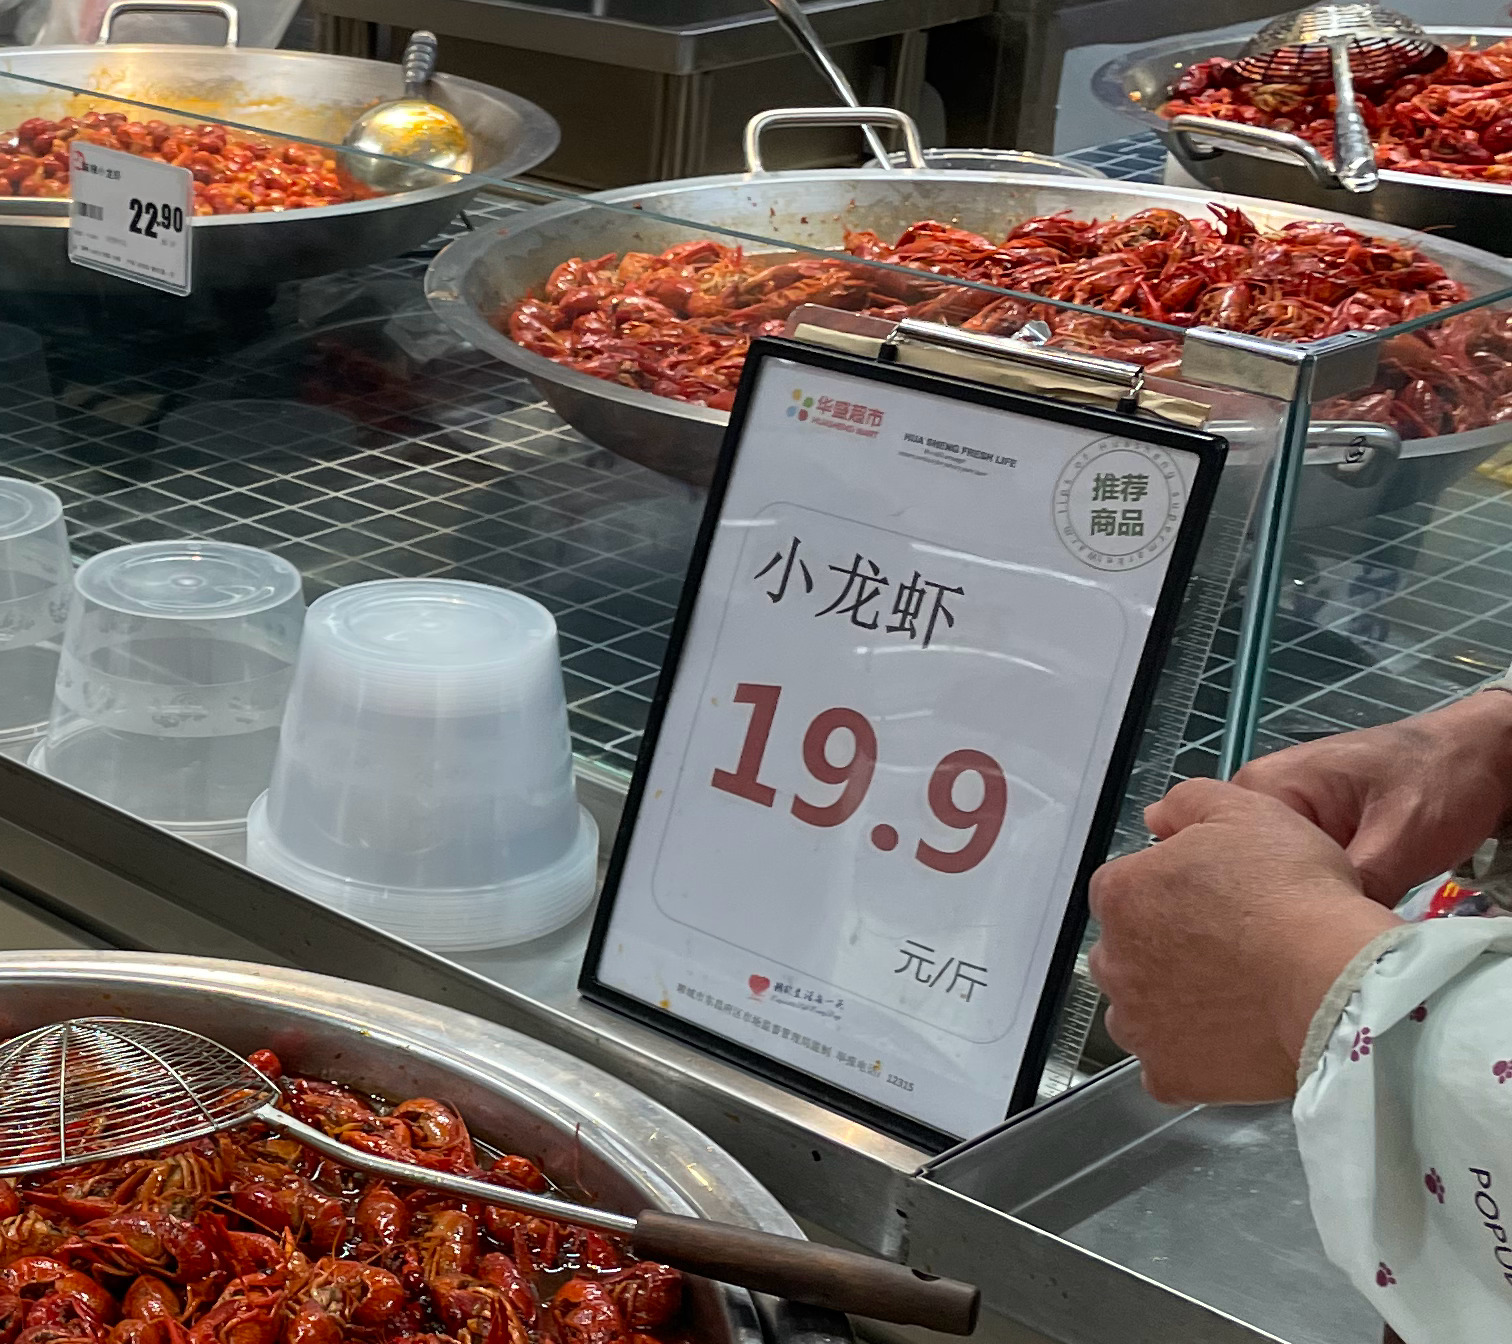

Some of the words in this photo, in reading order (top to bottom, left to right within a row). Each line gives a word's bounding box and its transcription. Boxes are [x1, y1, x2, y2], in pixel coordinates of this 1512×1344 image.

[129, 197, 183, 239] 22.90
[995, 455, 1017, 468] LIFE
[1092, 473, 1150, 502] 推荐
[1090, 508, 1144, 536] 商品
[754, 535, 964, 650] 小龙虾
[710, 682, 1008, 875] 19.9
[894, 938, 988, 1003] 元/斤
[886, 1073, 915, 1091] 12315
[1468, 1166, 1512, 1287] POPU
